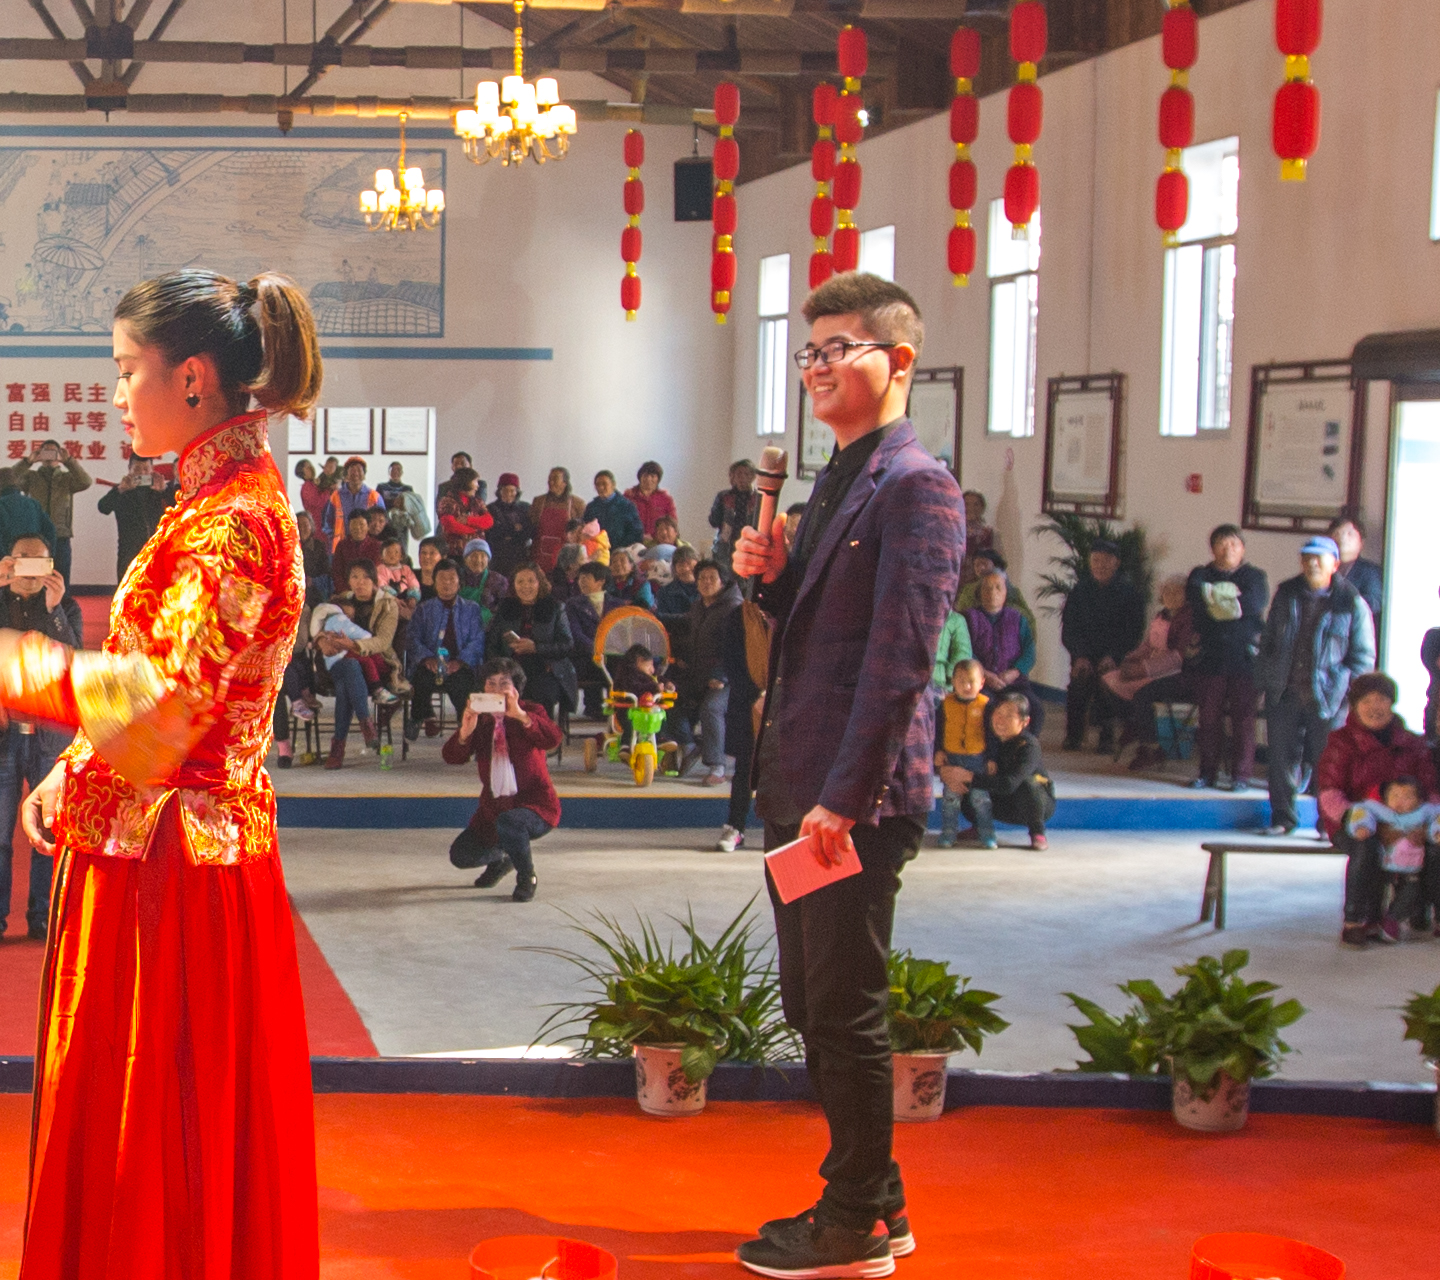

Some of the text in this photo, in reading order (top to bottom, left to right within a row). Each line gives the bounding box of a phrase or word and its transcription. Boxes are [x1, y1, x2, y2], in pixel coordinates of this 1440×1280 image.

[6, 382, 107, 402] 富强 民主
[9, 410, 107, 432] 自由 平等
[64, 439, 106, 460] 敬业
